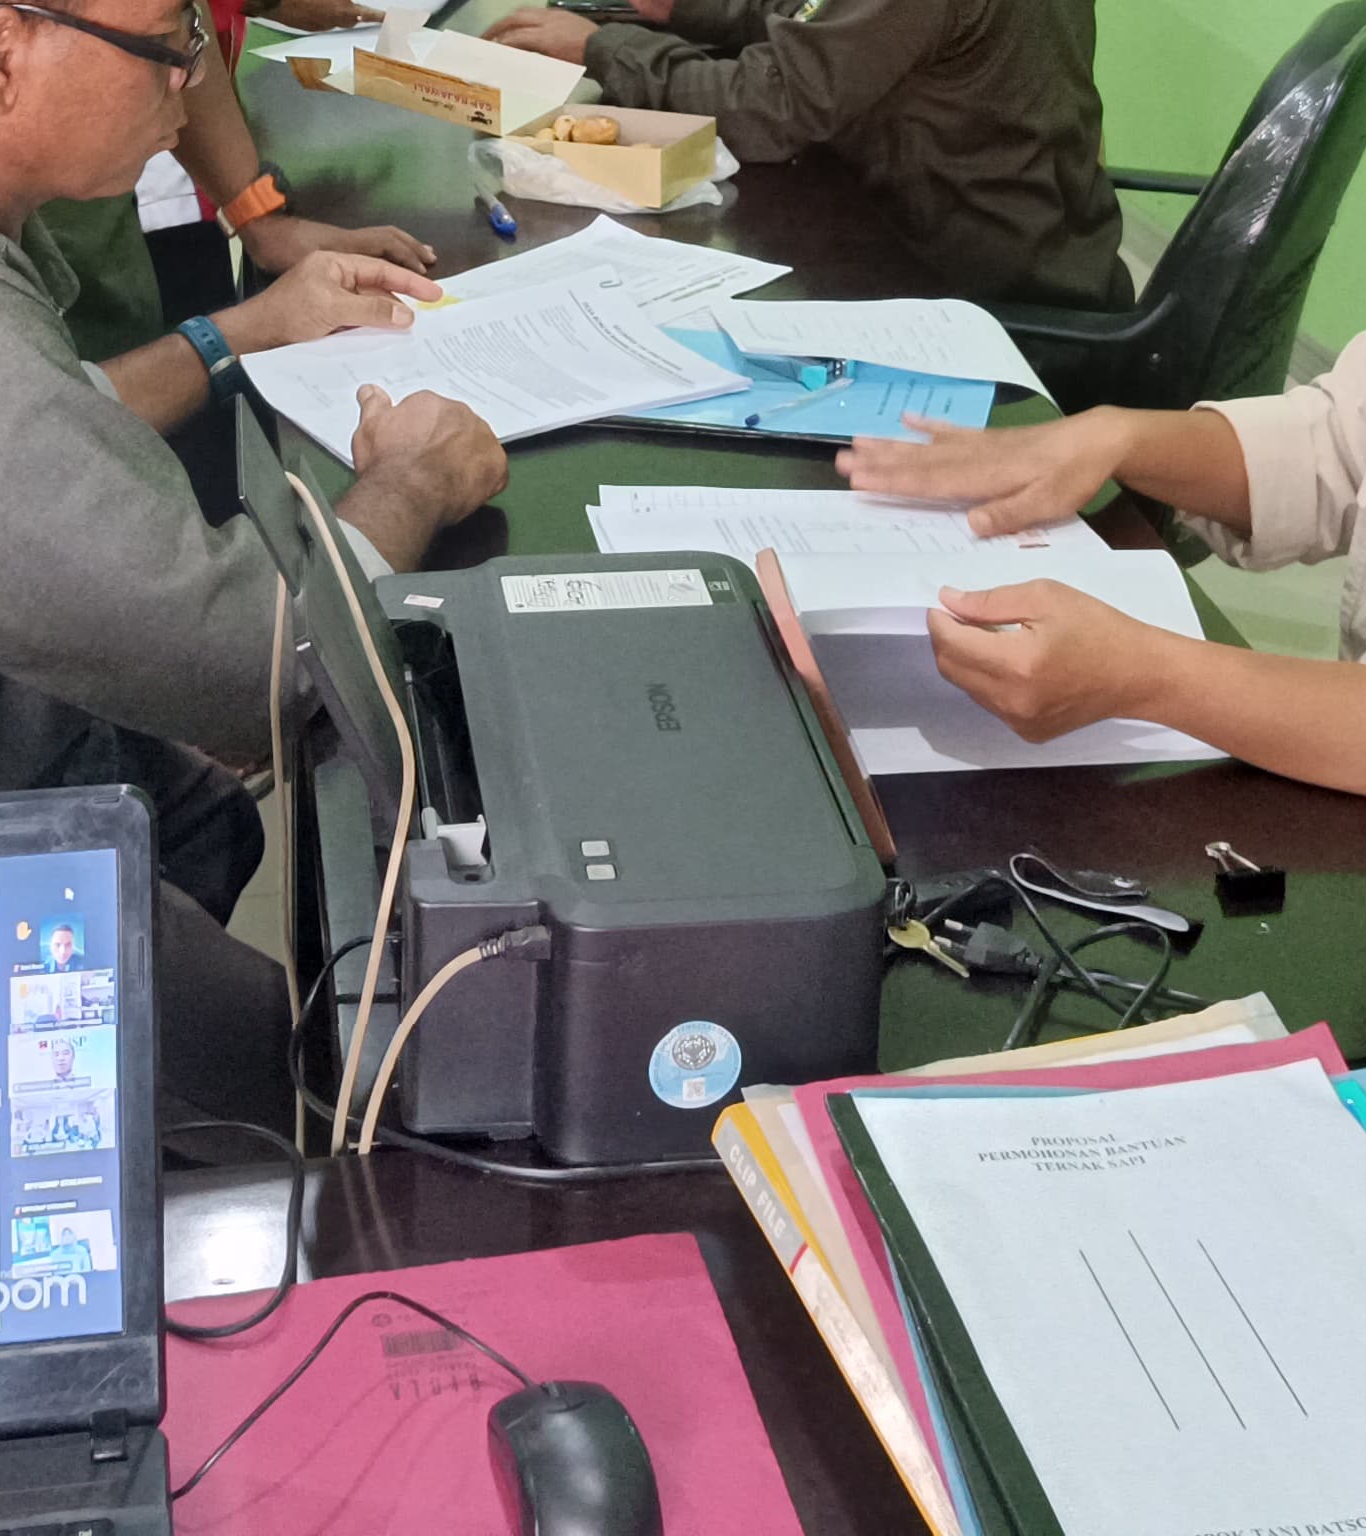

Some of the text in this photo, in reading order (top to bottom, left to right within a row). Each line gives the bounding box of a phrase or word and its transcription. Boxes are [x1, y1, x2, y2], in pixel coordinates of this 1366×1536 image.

[645, 681, 682, 732] EPSON
[978, 1135, 1187, 1162] PERMOHONAN BANTUAN
[1034, 1155, 1147, 1172] TERNAK SAPI
[729, 1143, 787, 1239] CLIP FILE
